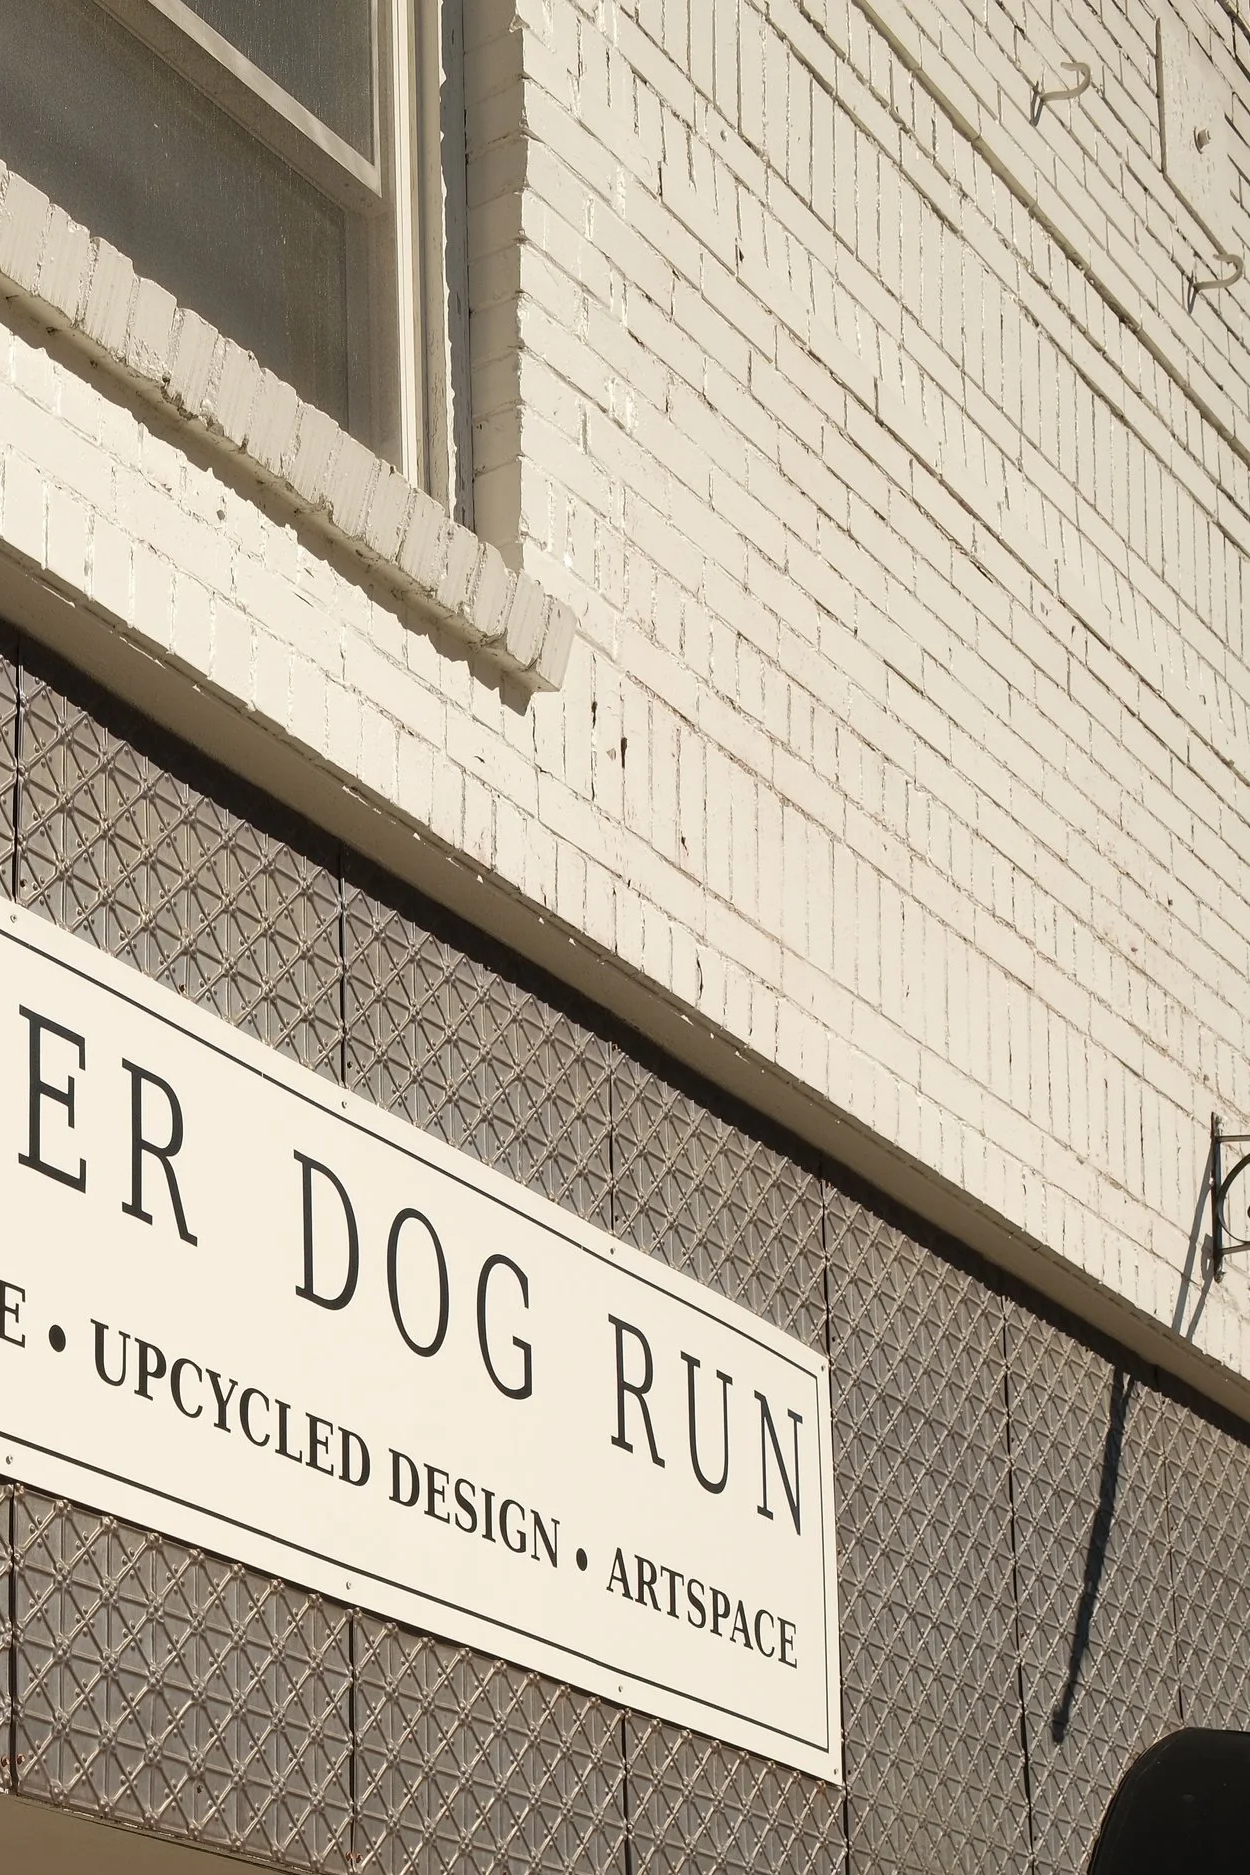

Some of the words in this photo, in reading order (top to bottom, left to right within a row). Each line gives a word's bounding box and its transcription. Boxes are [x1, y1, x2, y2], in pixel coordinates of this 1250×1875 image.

[90, 1317, 372, 1488] UPCYCLED
[388, 1447, 561, 1569] DESIGN
[606, 1547, 798, 1669] ARTSPACE
[293, 1148, 534, 1401] DOG
[607, 1312, 804, 1537] RUN
